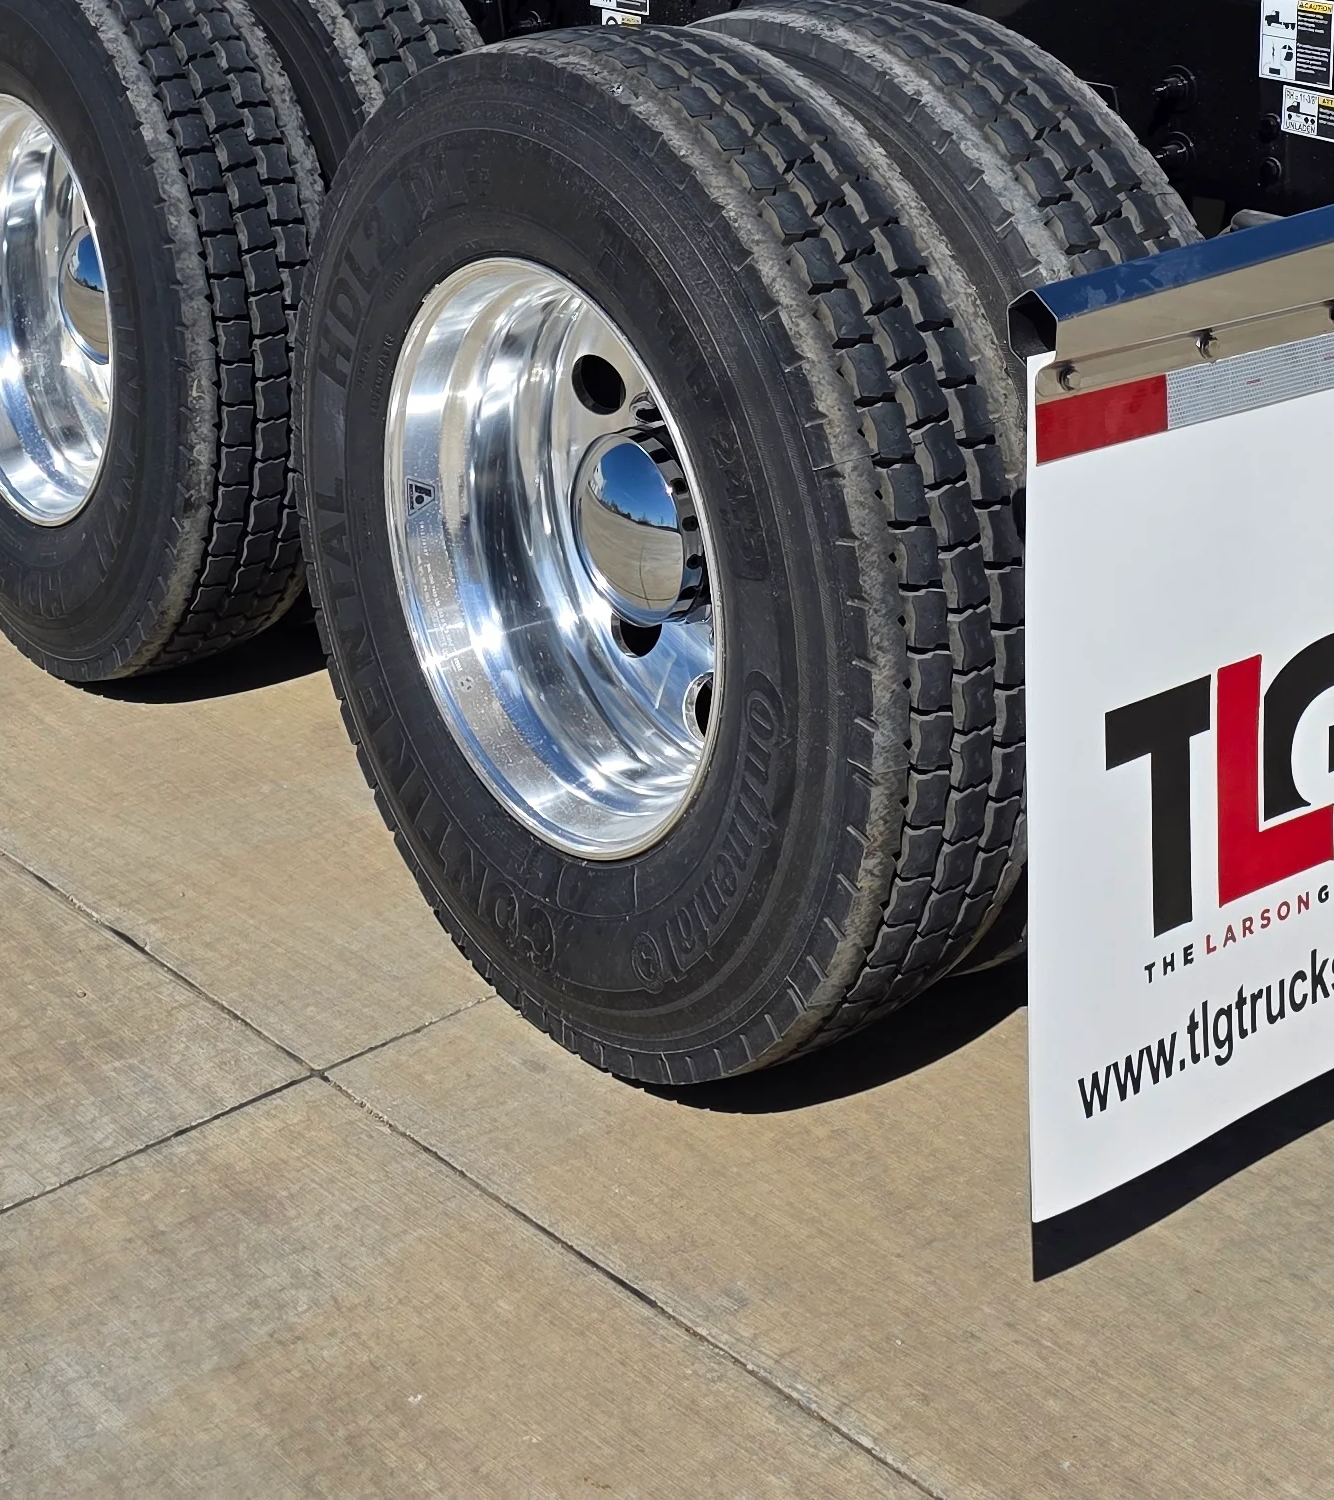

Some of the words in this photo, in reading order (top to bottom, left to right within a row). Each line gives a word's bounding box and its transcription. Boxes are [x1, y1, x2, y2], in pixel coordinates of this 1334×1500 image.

[1286, 120, 1316, 135] UNLADEN
[316, 202, 399, 391] HDL2
[315, 474, 557, 980] CONTINENTAL
[661, 666, 786, 982] Continental
[1143, 942, 1195, 984] THE
[1205, 891, 1310, 955] LARSON
